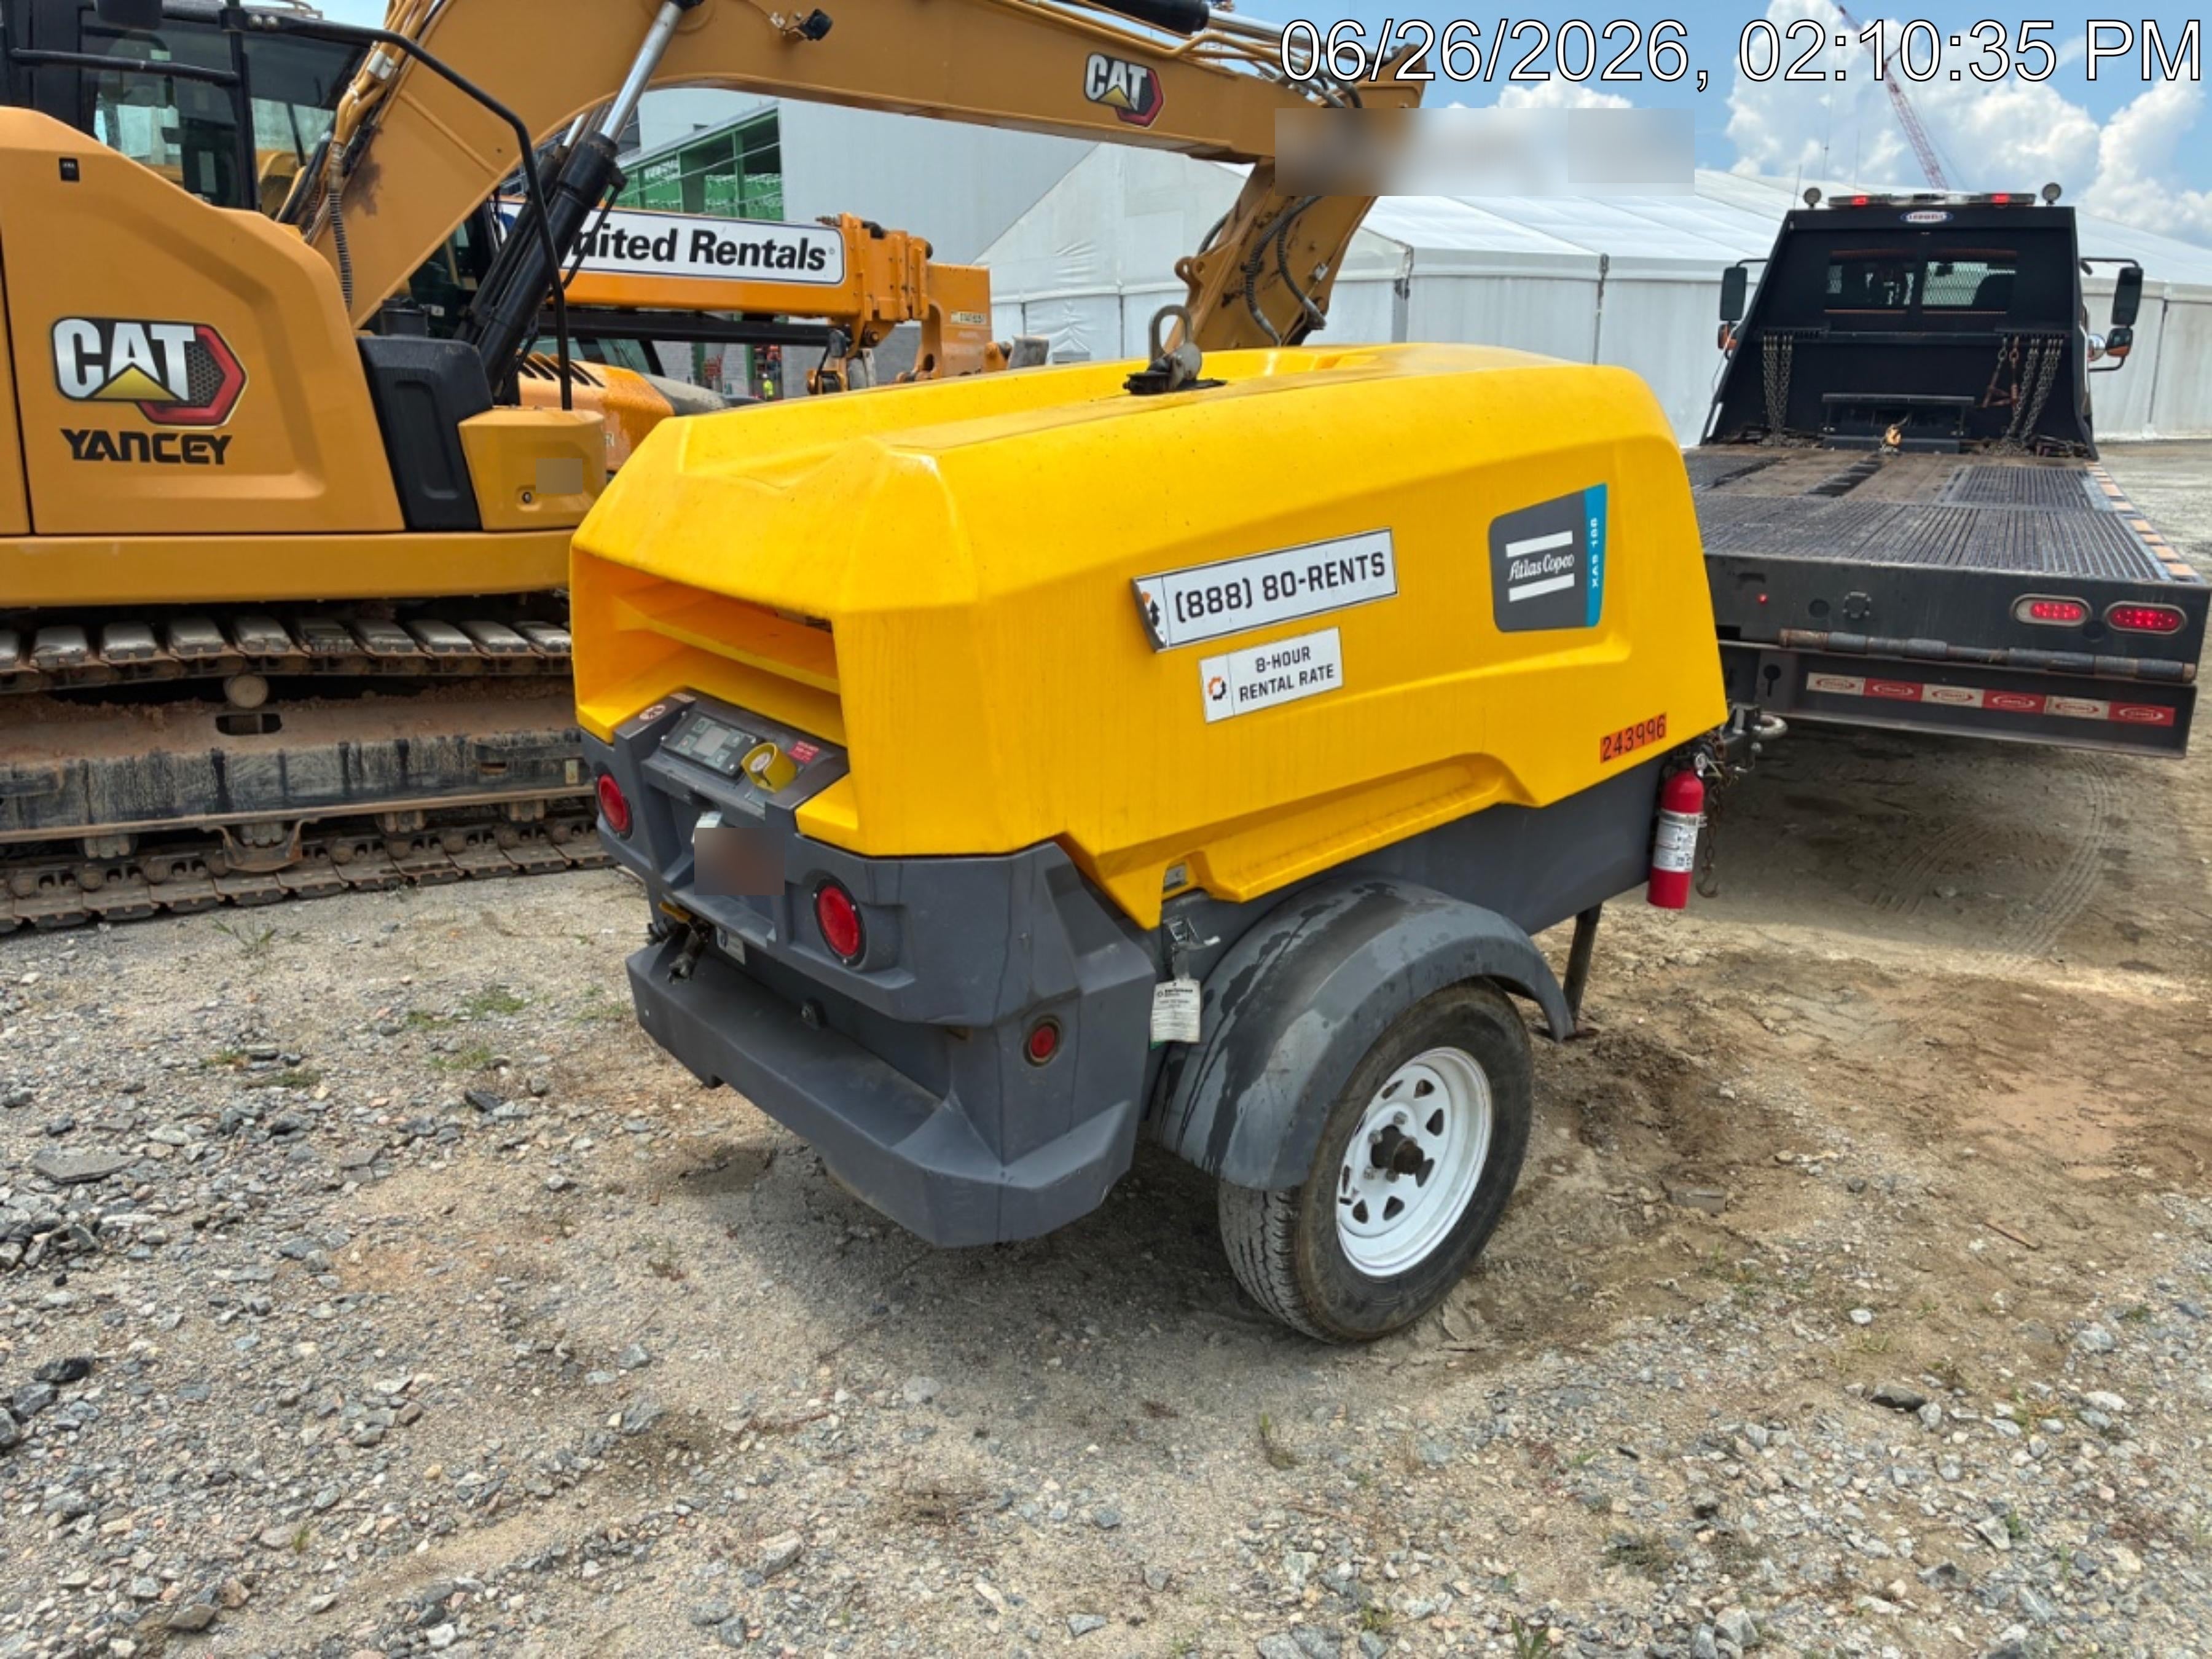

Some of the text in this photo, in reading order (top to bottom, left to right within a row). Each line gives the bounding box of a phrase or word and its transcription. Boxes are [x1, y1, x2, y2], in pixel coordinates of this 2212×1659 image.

[1085, 53, 1147, 111] CAT
[571, 222, 827, 270] nited Rentals
[53, 317, 196, 401] CAT
[60, 428, 232, 465] YANCEY
[1175, 551, 1386, 622] (888) 80-RENTS
[1508, 553, 1574, 582] Atlas Copco
[1255, 646, 1311, 673] 8-HOUR
[1239, 664, 1335, 703] RENTAL RATE
[1602, 715, 1665, 761] 243996
